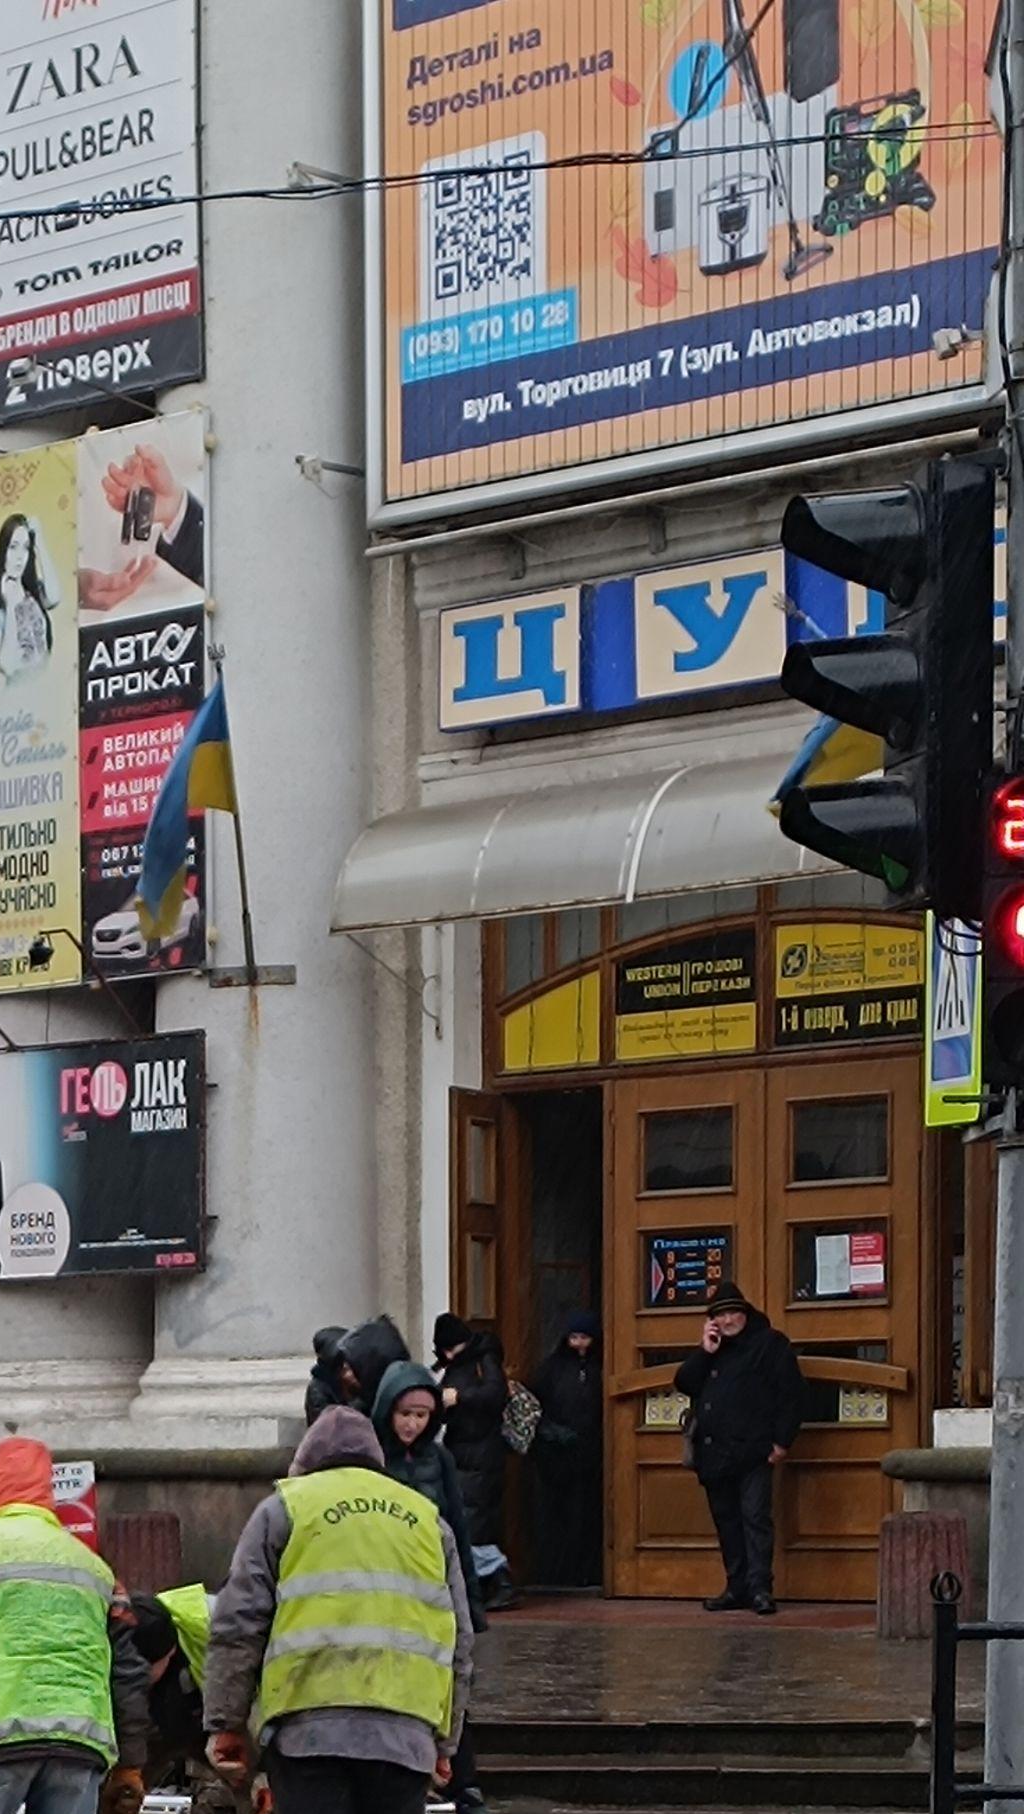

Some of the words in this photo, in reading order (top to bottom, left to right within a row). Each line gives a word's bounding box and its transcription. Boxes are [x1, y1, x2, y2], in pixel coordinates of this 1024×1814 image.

[6, 34, 142, 114] ZARA
[407, 32, 500, 90] Деталі
[508, 28, 542, 54] на
[407, 49, 615, 127] sgroshi.com.ua
[14, 265, 82, 295] TOM
[88, 238, 183, 277] TAILOR
[59, 312, 71, 336] В
[73, 299, 140, 335] ОДНОМУ
[143, 280, 191, 316] МІСЦІ
[409, 325, 459, 365] (093)
[467, 315, 503, 345] 170
[510, 308, 535, 336] 10
[462, 391, 511, 426] вул.
[517, 358, 652, 408] Торговиця
[657, 349, 675, 377] 7
[679, 343, 740, 378] (зуп.
[746, 294, 921, 358] Автовокзал)
[36, 338, 152, 393] поверх
[87, 661, 196, 701] ПРОКАТ
[103, 722, 185, 754] ВЕЛИКИЙ
[626, 963, 681, 981] WESTERN
[61, 1063, 127, 1115] ГЕЛЬ
[131, 1059, 186, 1108] ЛАК
[131, 1108, 187, 1132] МАГАЗИН
[10, 1212, 55, 1229] БРЕНД
[10, 1232, 56, 1245] НОВОГО
[323, 1498, 419, 1530] ORDNER
